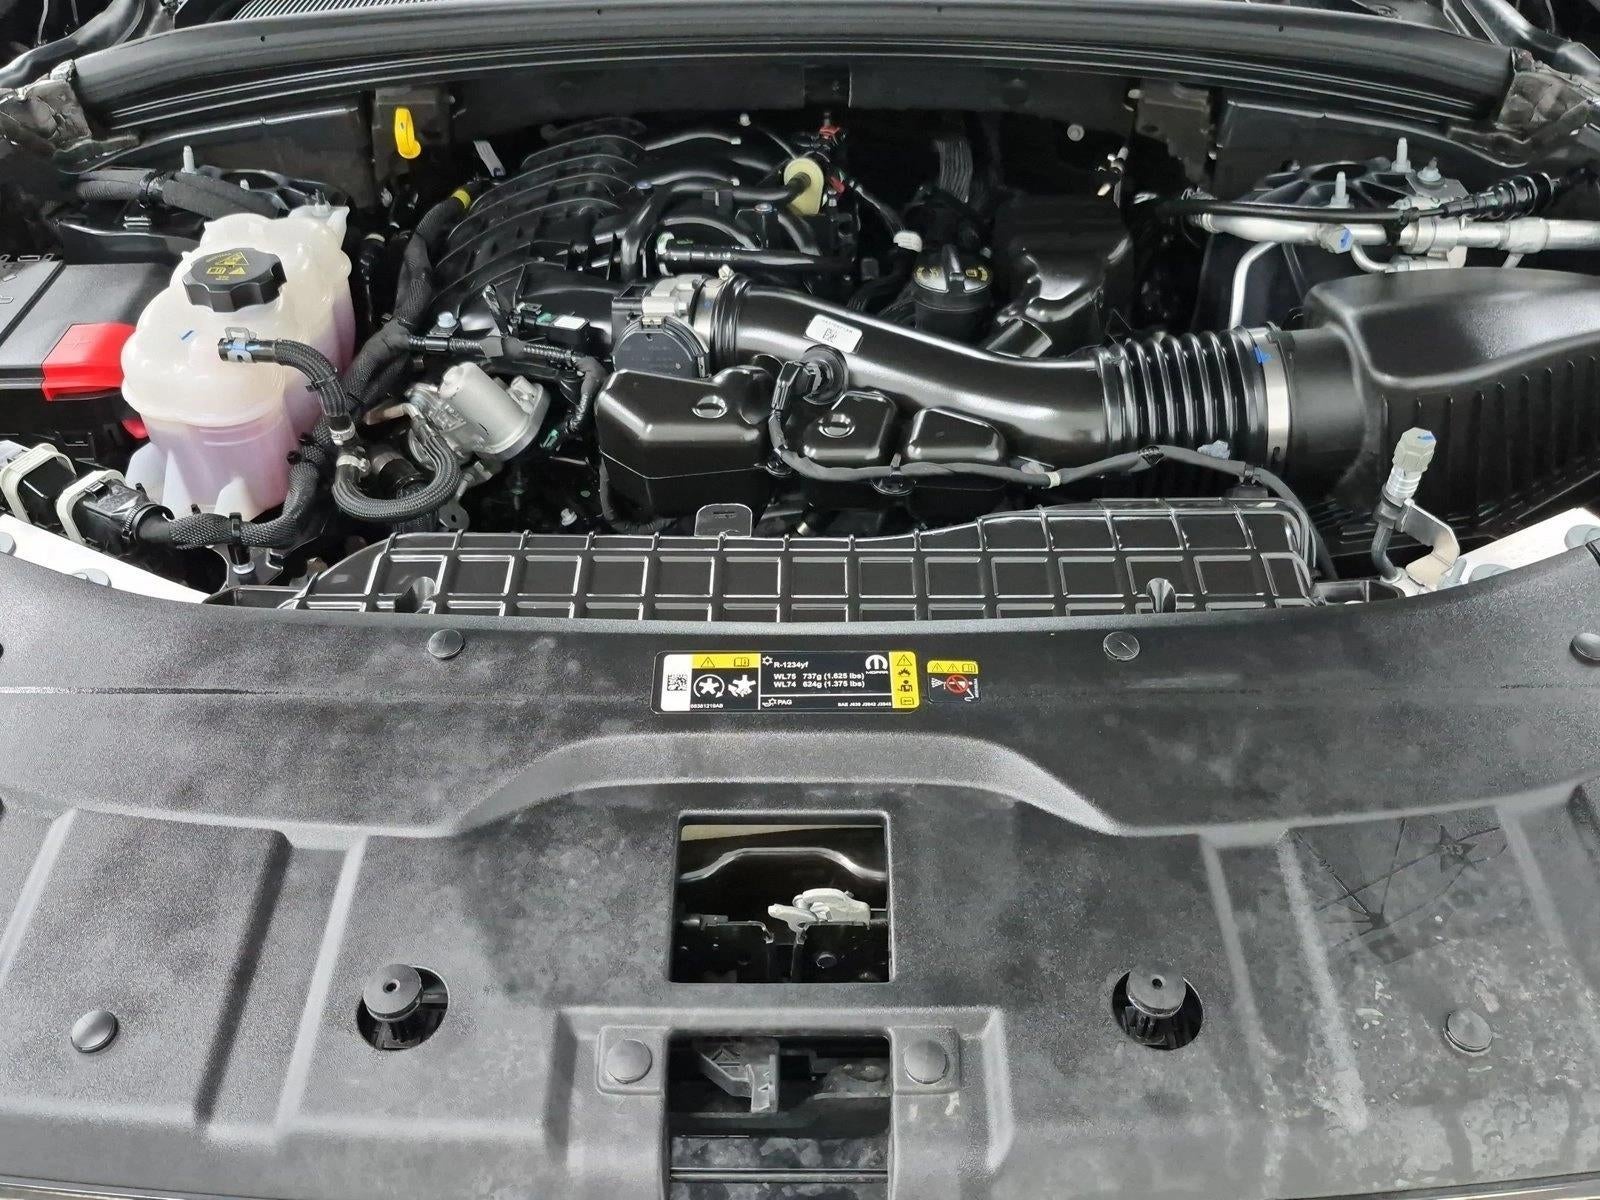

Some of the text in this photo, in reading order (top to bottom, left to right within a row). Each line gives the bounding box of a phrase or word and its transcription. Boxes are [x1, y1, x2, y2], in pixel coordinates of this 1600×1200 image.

[773, 661, 809, 669] R-1234yf
[802, 673, 822, 681] 737g
[823, 672, 848, 680] (1.625
[849, 672, 865, 680] lbs)
[802, 681, 822, 689] 624g
[823, 680, 848, 688] (1.375
[849, 680, 865, 688] lbs)
